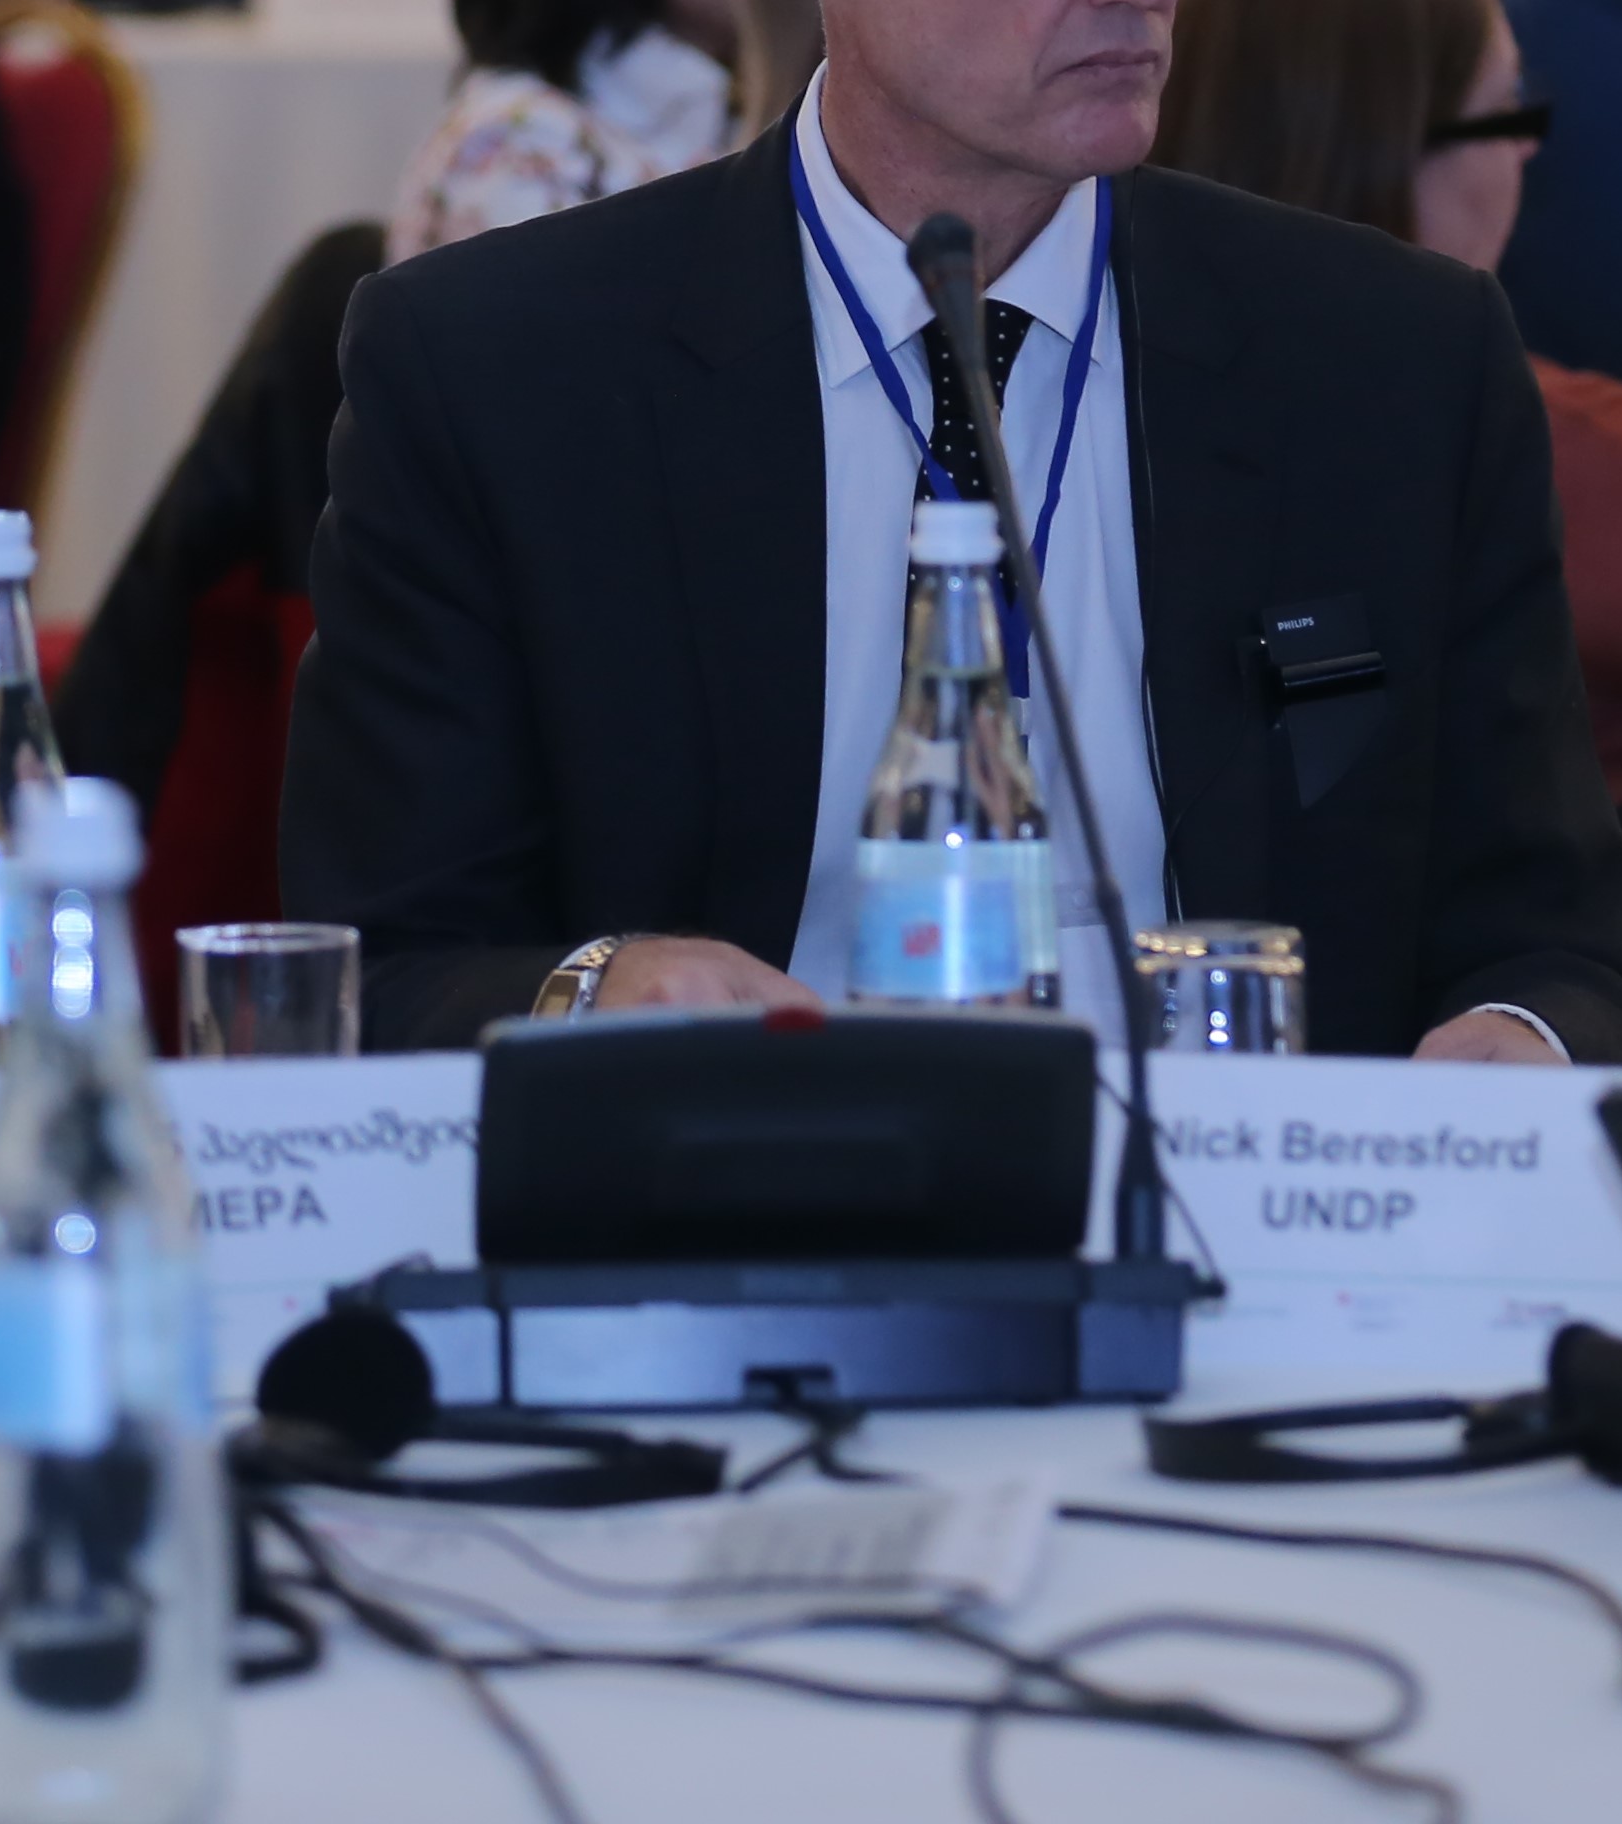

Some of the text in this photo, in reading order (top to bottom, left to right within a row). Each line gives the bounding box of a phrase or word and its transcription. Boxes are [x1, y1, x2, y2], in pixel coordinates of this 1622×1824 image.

[1277, 616, 1315, 631] PHILIPS
[197, 1107, 475, 1174] პავლიაშვი
[1282, 1120, 1541, 1170] Beresford
[1262, 1186, 1416, 1232] UNDP
